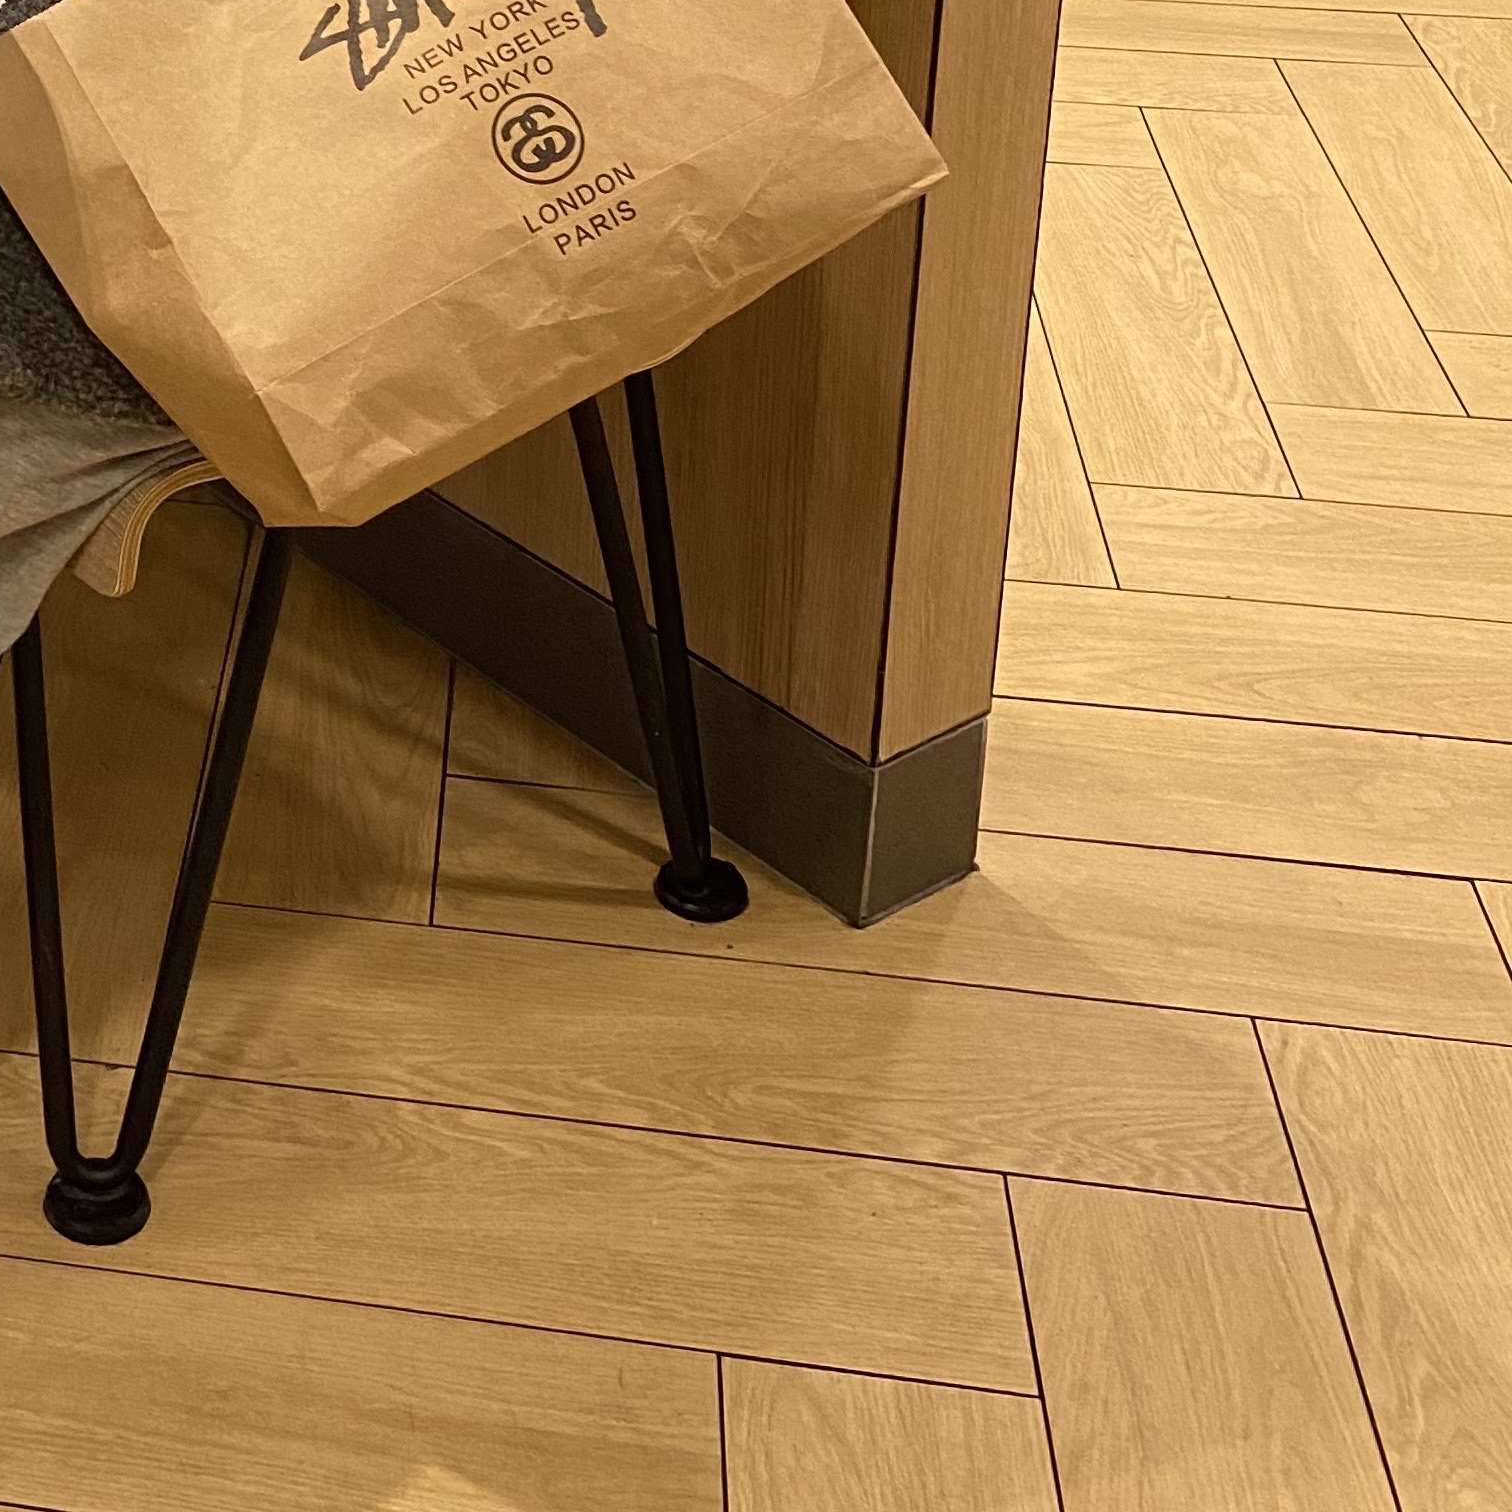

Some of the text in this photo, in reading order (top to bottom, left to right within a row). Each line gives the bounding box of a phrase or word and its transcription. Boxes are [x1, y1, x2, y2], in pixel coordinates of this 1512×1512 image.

[402, 10, 580, 116] LOS ANGELES
[403, 33, 464, 79] NEW
[459, 54, 554, 113] TOKYO
[522, 162, 636, 234] LONDON
[554, 200, 637, 256] PARIS
